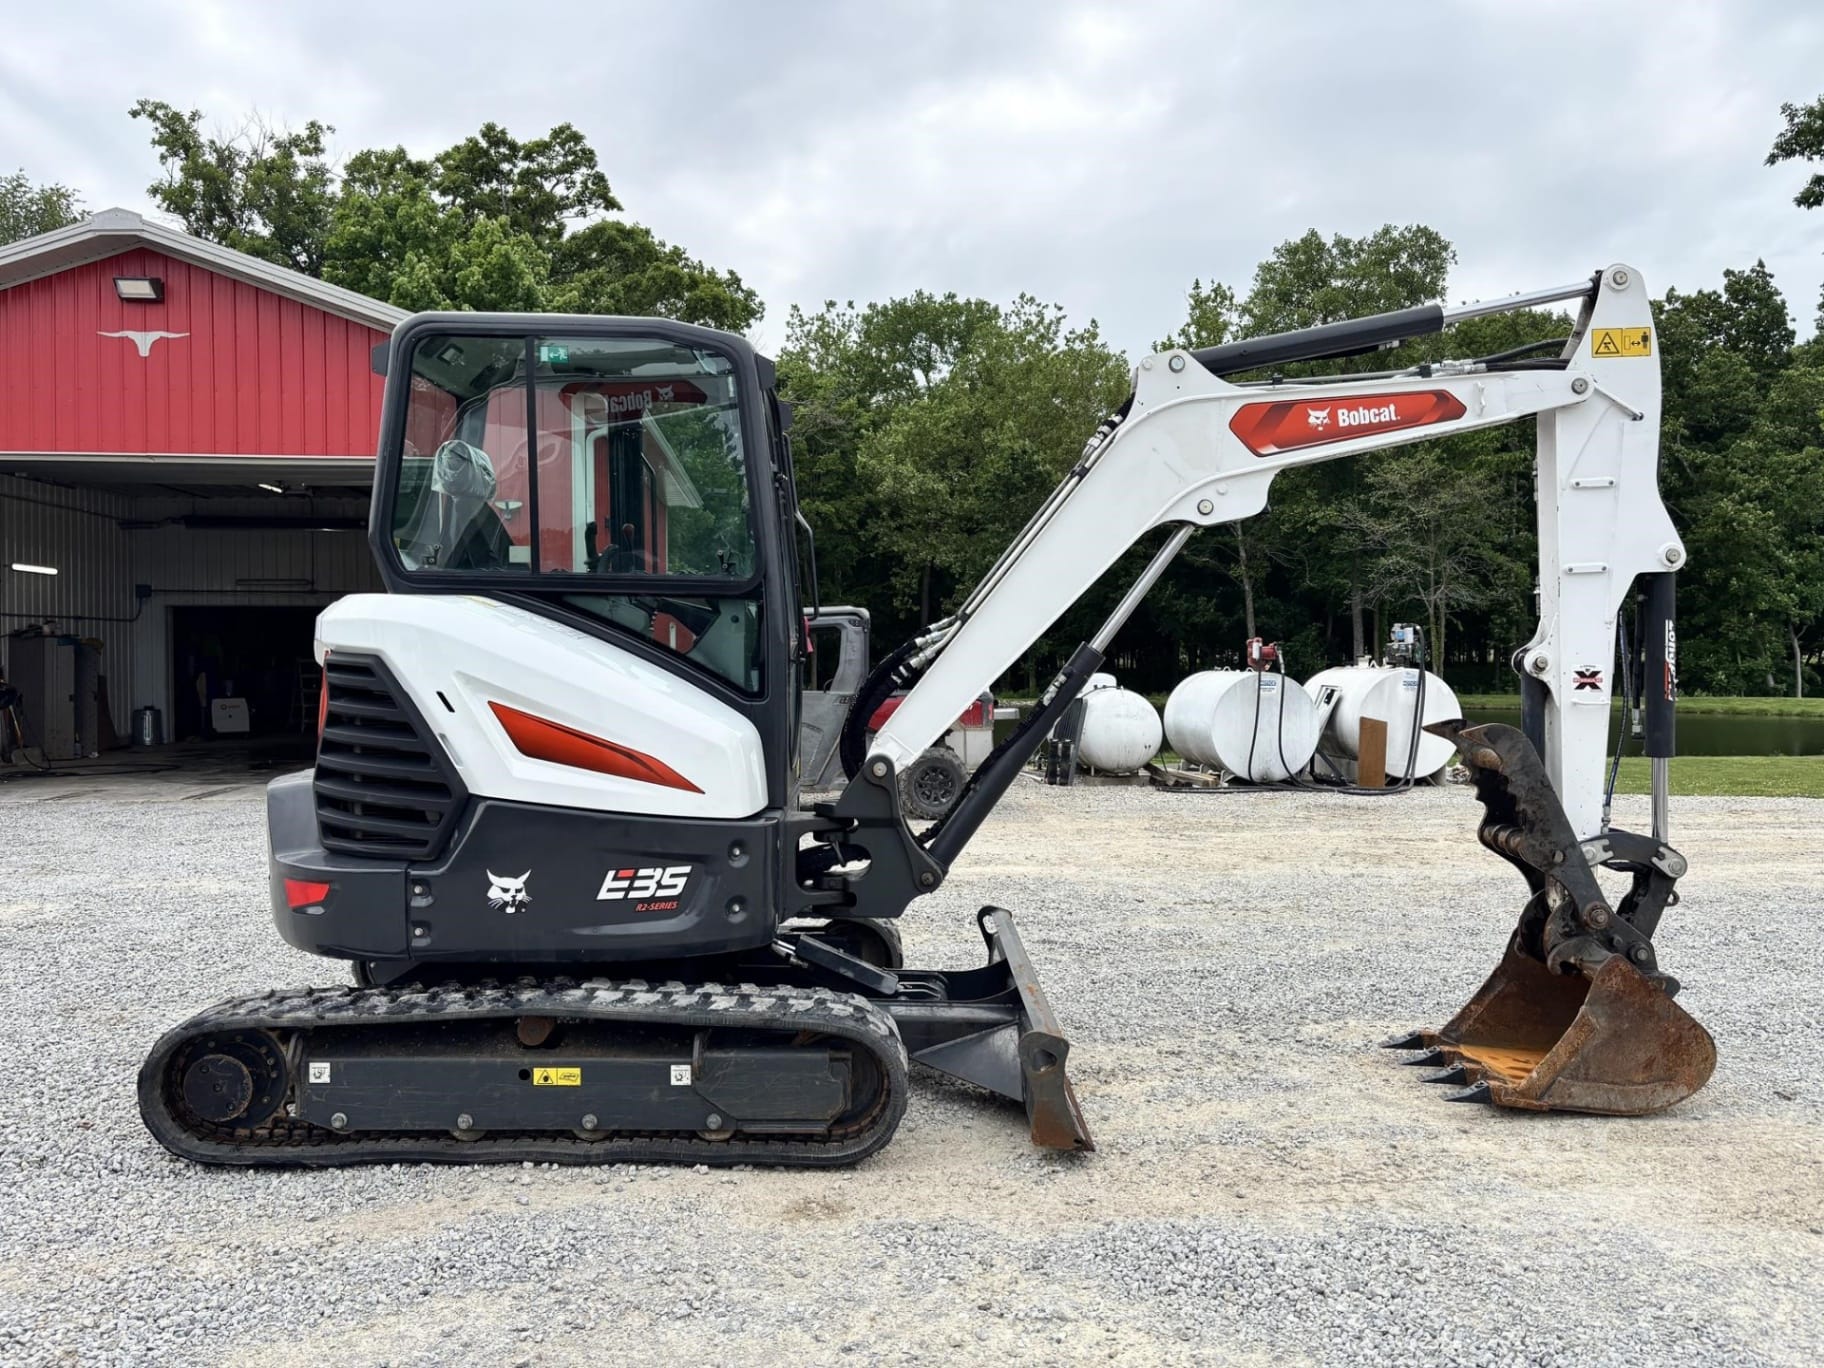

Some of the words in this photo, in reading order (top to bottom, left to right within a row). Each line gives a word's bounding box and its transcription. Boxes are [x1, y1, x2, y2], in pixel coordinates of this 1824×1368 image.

[1337, 403, 1397, 427] Bobcat
[596, 865, 692, 900] E35
[635, 901, 678, 911] R2-SERIES
